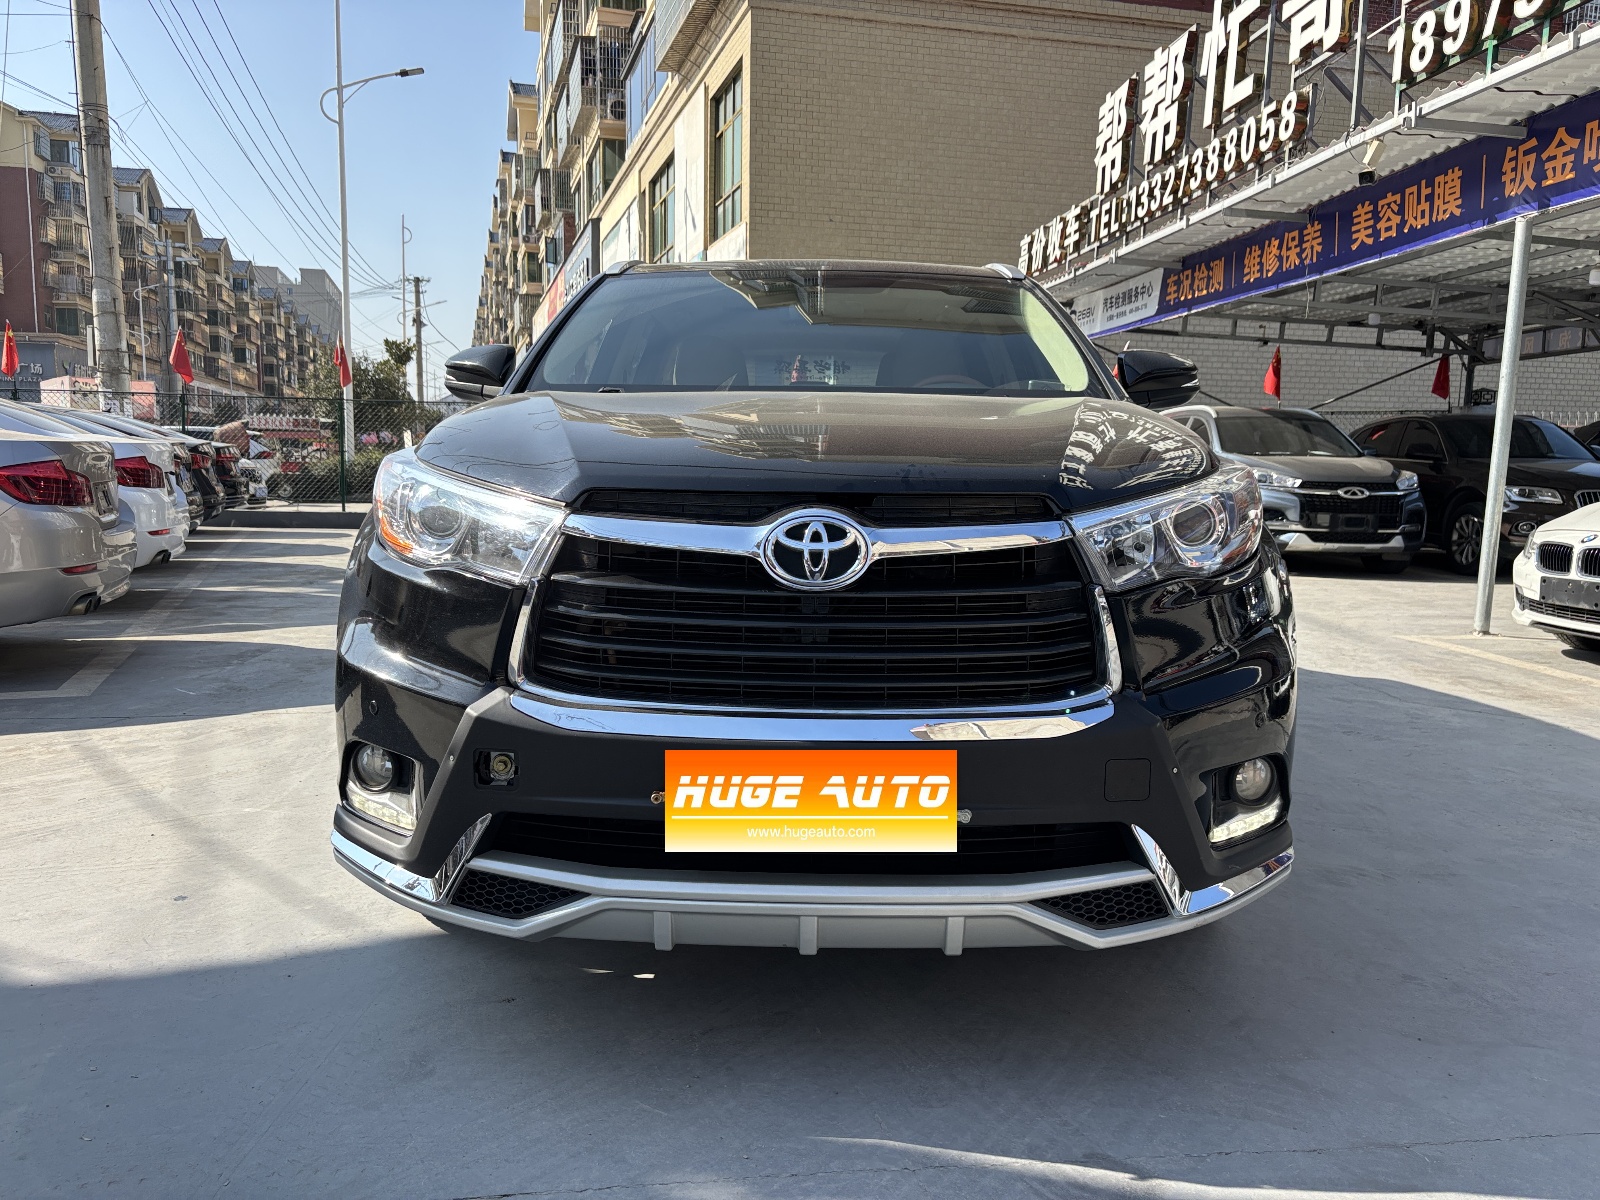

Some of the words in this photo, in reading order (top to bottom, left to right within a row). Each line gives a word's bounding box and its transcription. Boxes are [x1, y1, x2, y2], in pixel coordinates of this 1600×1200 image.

[1388, 0, 1543, 83] 1897
[1018, 204, 1081, 275] 高价收车
[1165, 256, 1225, 305] 车况检测
[1243, 221, 1322, 283] 维修保养
[1351, 166, 1463, 251] 美容贴膜
[1102, 280, 1154, 314] 汽车检测服务中心
